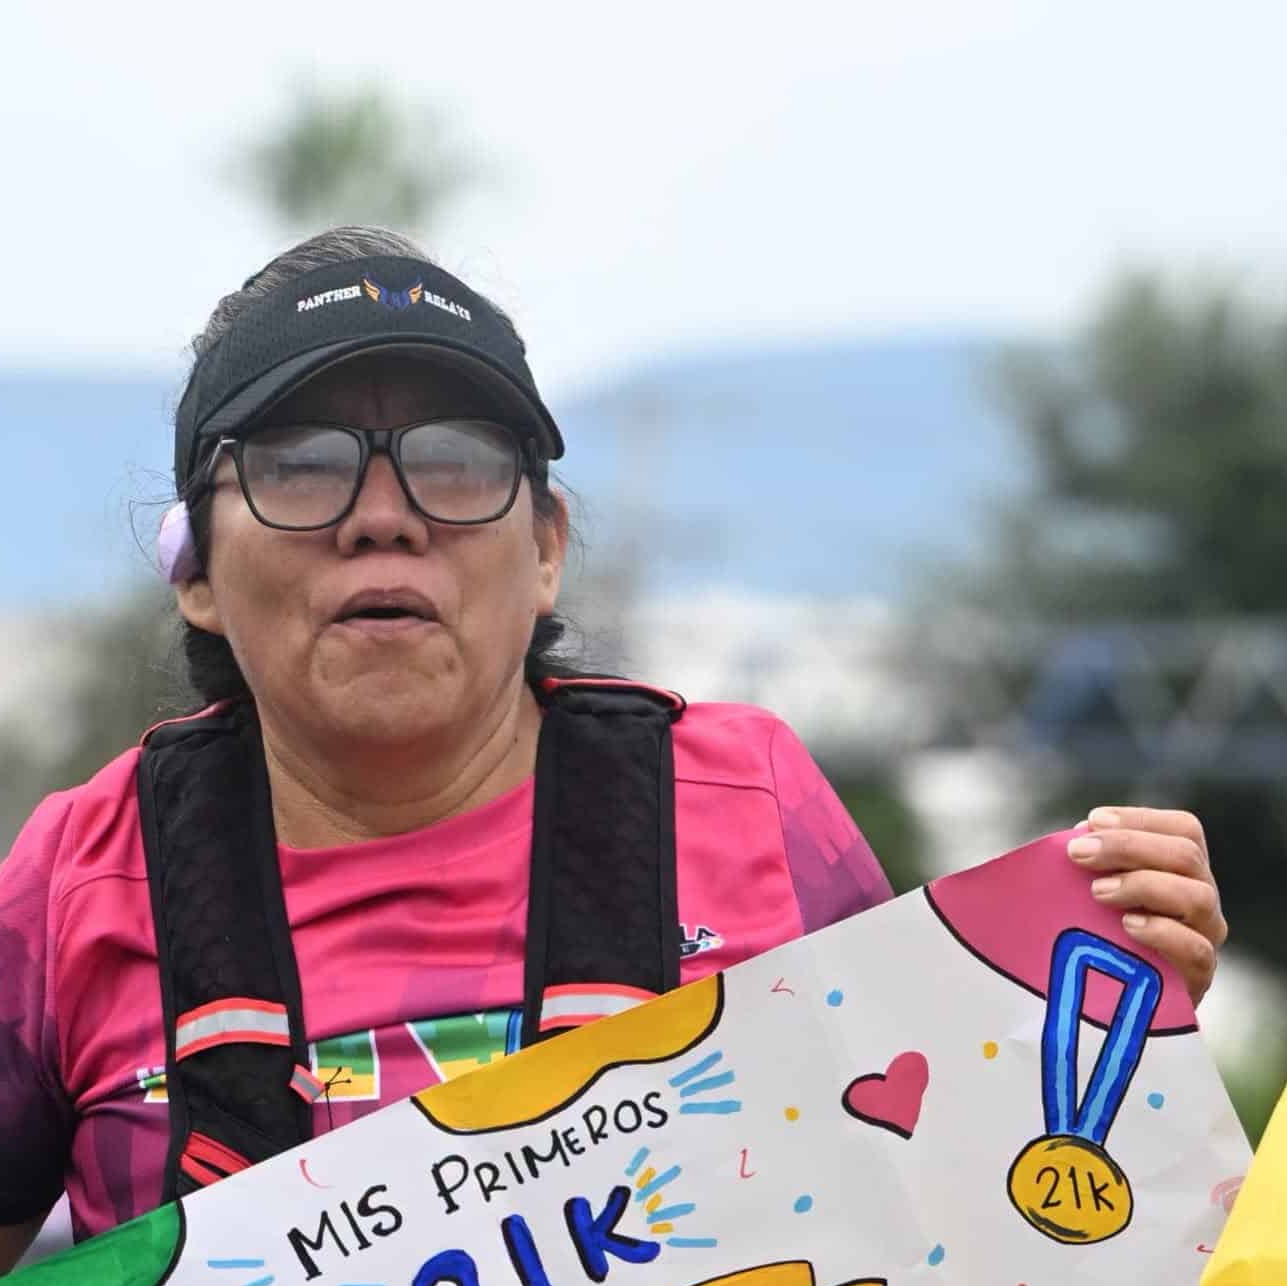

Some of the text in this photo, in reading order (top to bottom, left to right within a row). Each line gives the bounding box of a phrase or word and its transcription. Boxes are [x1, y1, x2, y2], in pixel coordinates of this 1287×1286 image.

[297, 285, 472, 321] PANTHER RELAYS
[287, 1091, 668, 1281] MIS PRIMEROS
